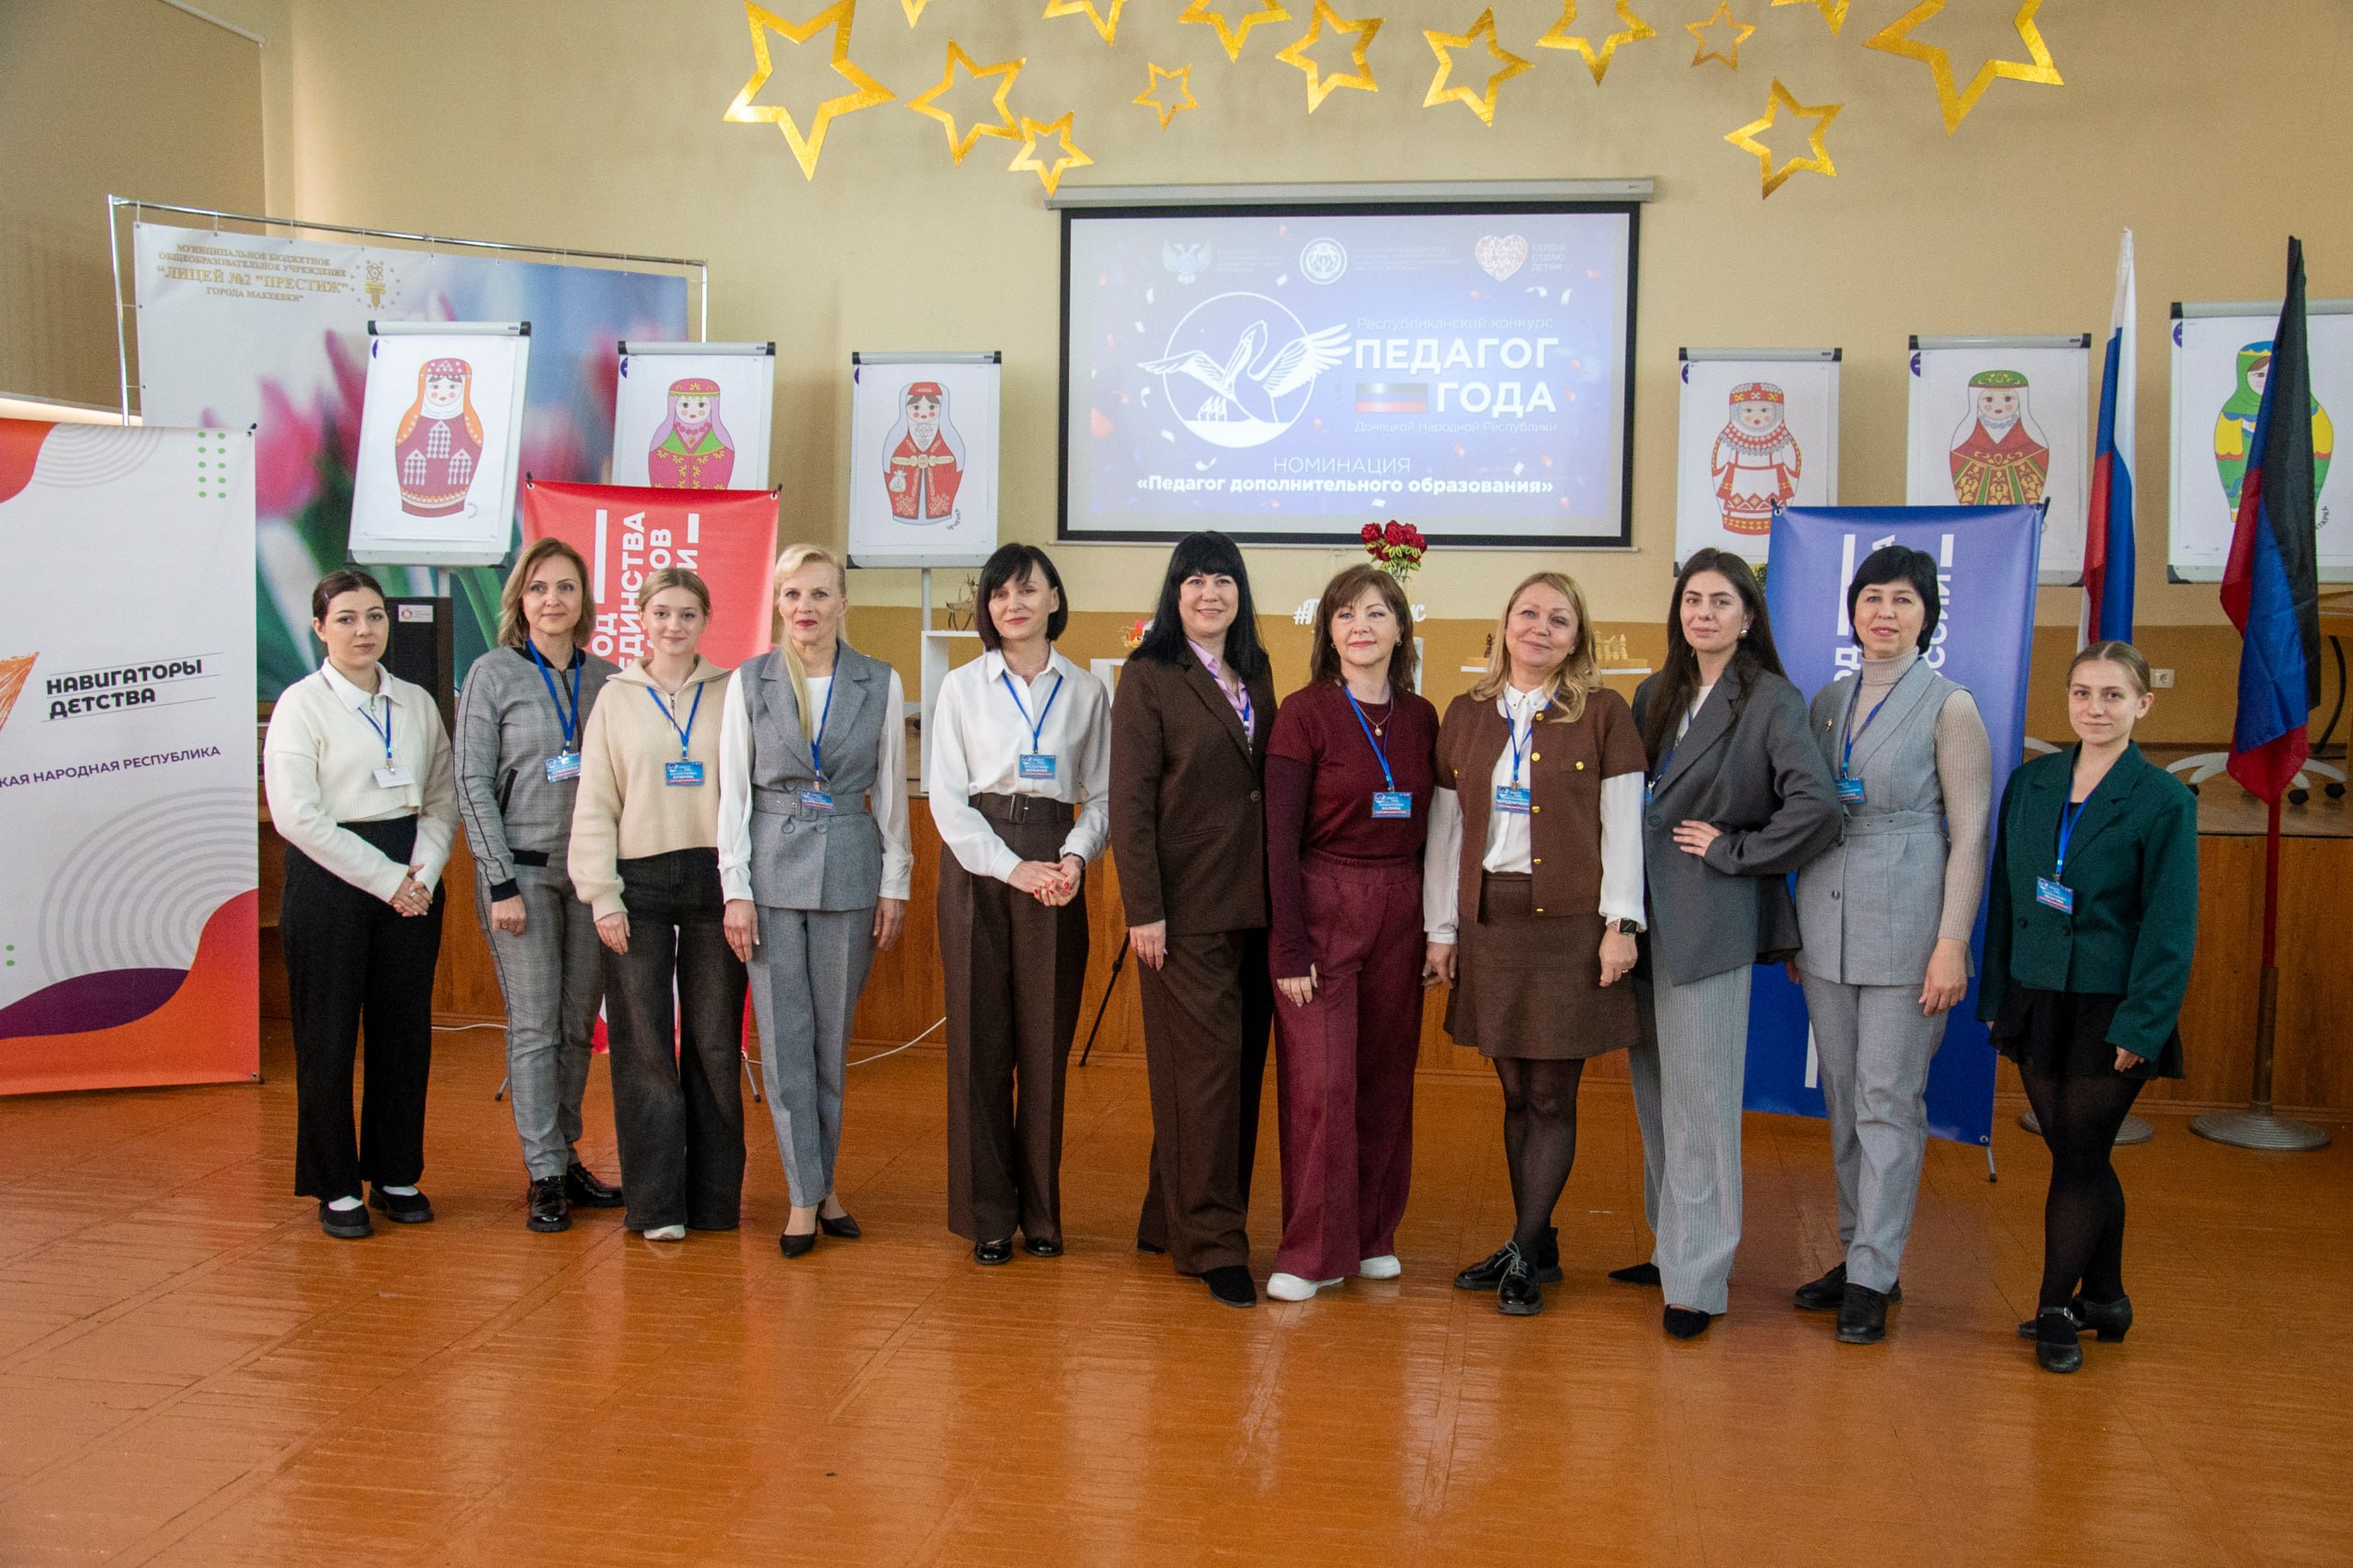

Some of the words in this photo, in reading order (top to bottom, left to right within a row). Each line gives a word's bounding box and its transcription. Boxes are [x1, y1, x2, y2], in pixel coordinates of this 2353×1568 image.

[158, 252, 280, 271] ОБЩЕОБРАЗОВАТЕЛЬНОЕ
[282, 264, 347, 277] УЧРЕЖДЕНИЕ
[176, 244, 267, 259] МУНИЦИПАЛЬНОЕ
[268, 253, 331, 266] БЮДЖЕТНОЕ
[207, 287, 244, 298] ГОРОДА
[1357, 317, 1487, 332] Республиканский
[1492, 318, 1553, 331] конкурс
[1355, 337, 1560, 375] ПЕДАГОГ
[1437, 381, 1557, 418] ГОДА
[1354, 421, 1415, 434] Донецкой
[1418, 421, 1480, 434] Народной
[1483, 421, 1558, 434] Республики
[1273, 457, 1411, 476] НОМИНАЦИЯ
[1136, 475, 1226, 493] «Педагог
[1230, 478, 1404, 493] дополнительного
[1408, 477, 1553, 495] образования»
[591, 612, 618, 656] ОД
[46, 659, 203, 695] НАВИГАТОРЫ
[49, 687, 156, 720] ДЕТСТВА
[33, 760, 120, 783] НАРОДНАЯ
[123, 745, 222, 769] РЕСПУБЛИКА
